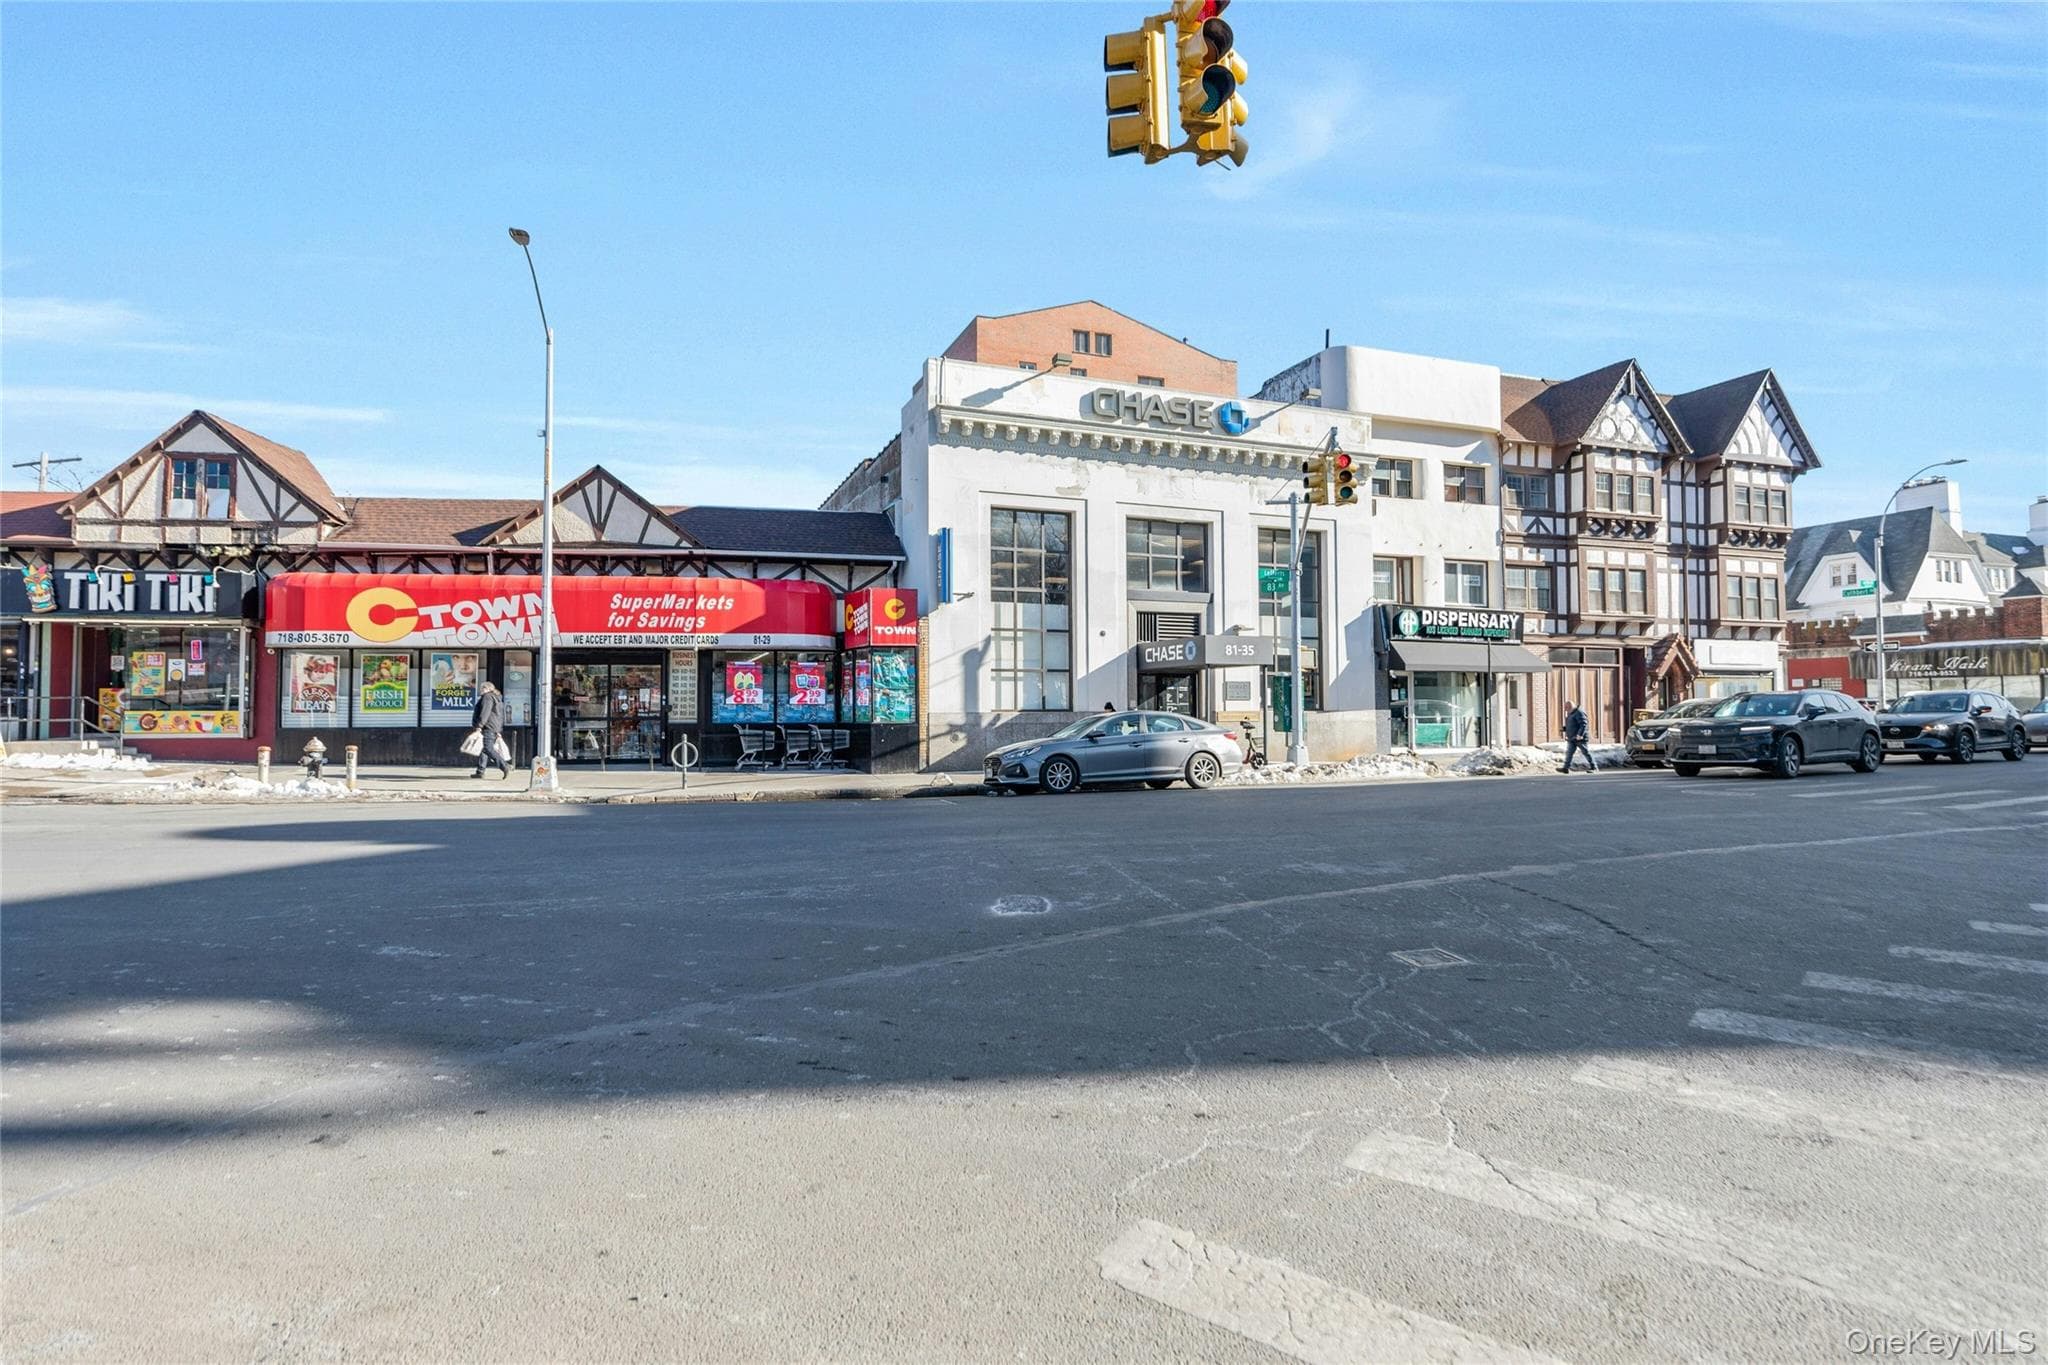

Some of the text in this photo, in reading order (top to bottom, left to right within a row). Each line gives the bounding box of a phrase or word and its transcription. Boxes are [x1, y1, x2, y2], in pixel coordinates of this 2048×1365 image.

[1093, 388, 1214, 430] CHASE
[417, 593, 555, 628] TOWN
[884, 598, 906, 620] C
[608, 612, 706, 632] for Savings
[1422, 609, 1519, 629] DISPENSARY
[875, 626, 917, 635] TOWN
[278, 633, 349, 645] 718-805-3670
[573, 635, 719, 645] WE ACCEPT EBT AND MAJOR CREDIT CARDS
[753, 636, 771, 645] 81-29
[1145, 644, 1184, 663] CHASE
[1225, 644, 1255, 656] 81-35
[1937, 656, 1989, 671] Nails
[298, 686, 331, 702] FRESH
[366, 690, 404, 700] FRESH
[435, 689, 472, 697] FORGET
[733, 689, 759, 704] 8 99
[797, 689, 821, 704] 2 99
[295, 700, 333, 711] MEATS
[366, 700, 403, 708] PRODUCE
[441, 697, 474, 708] MILK
